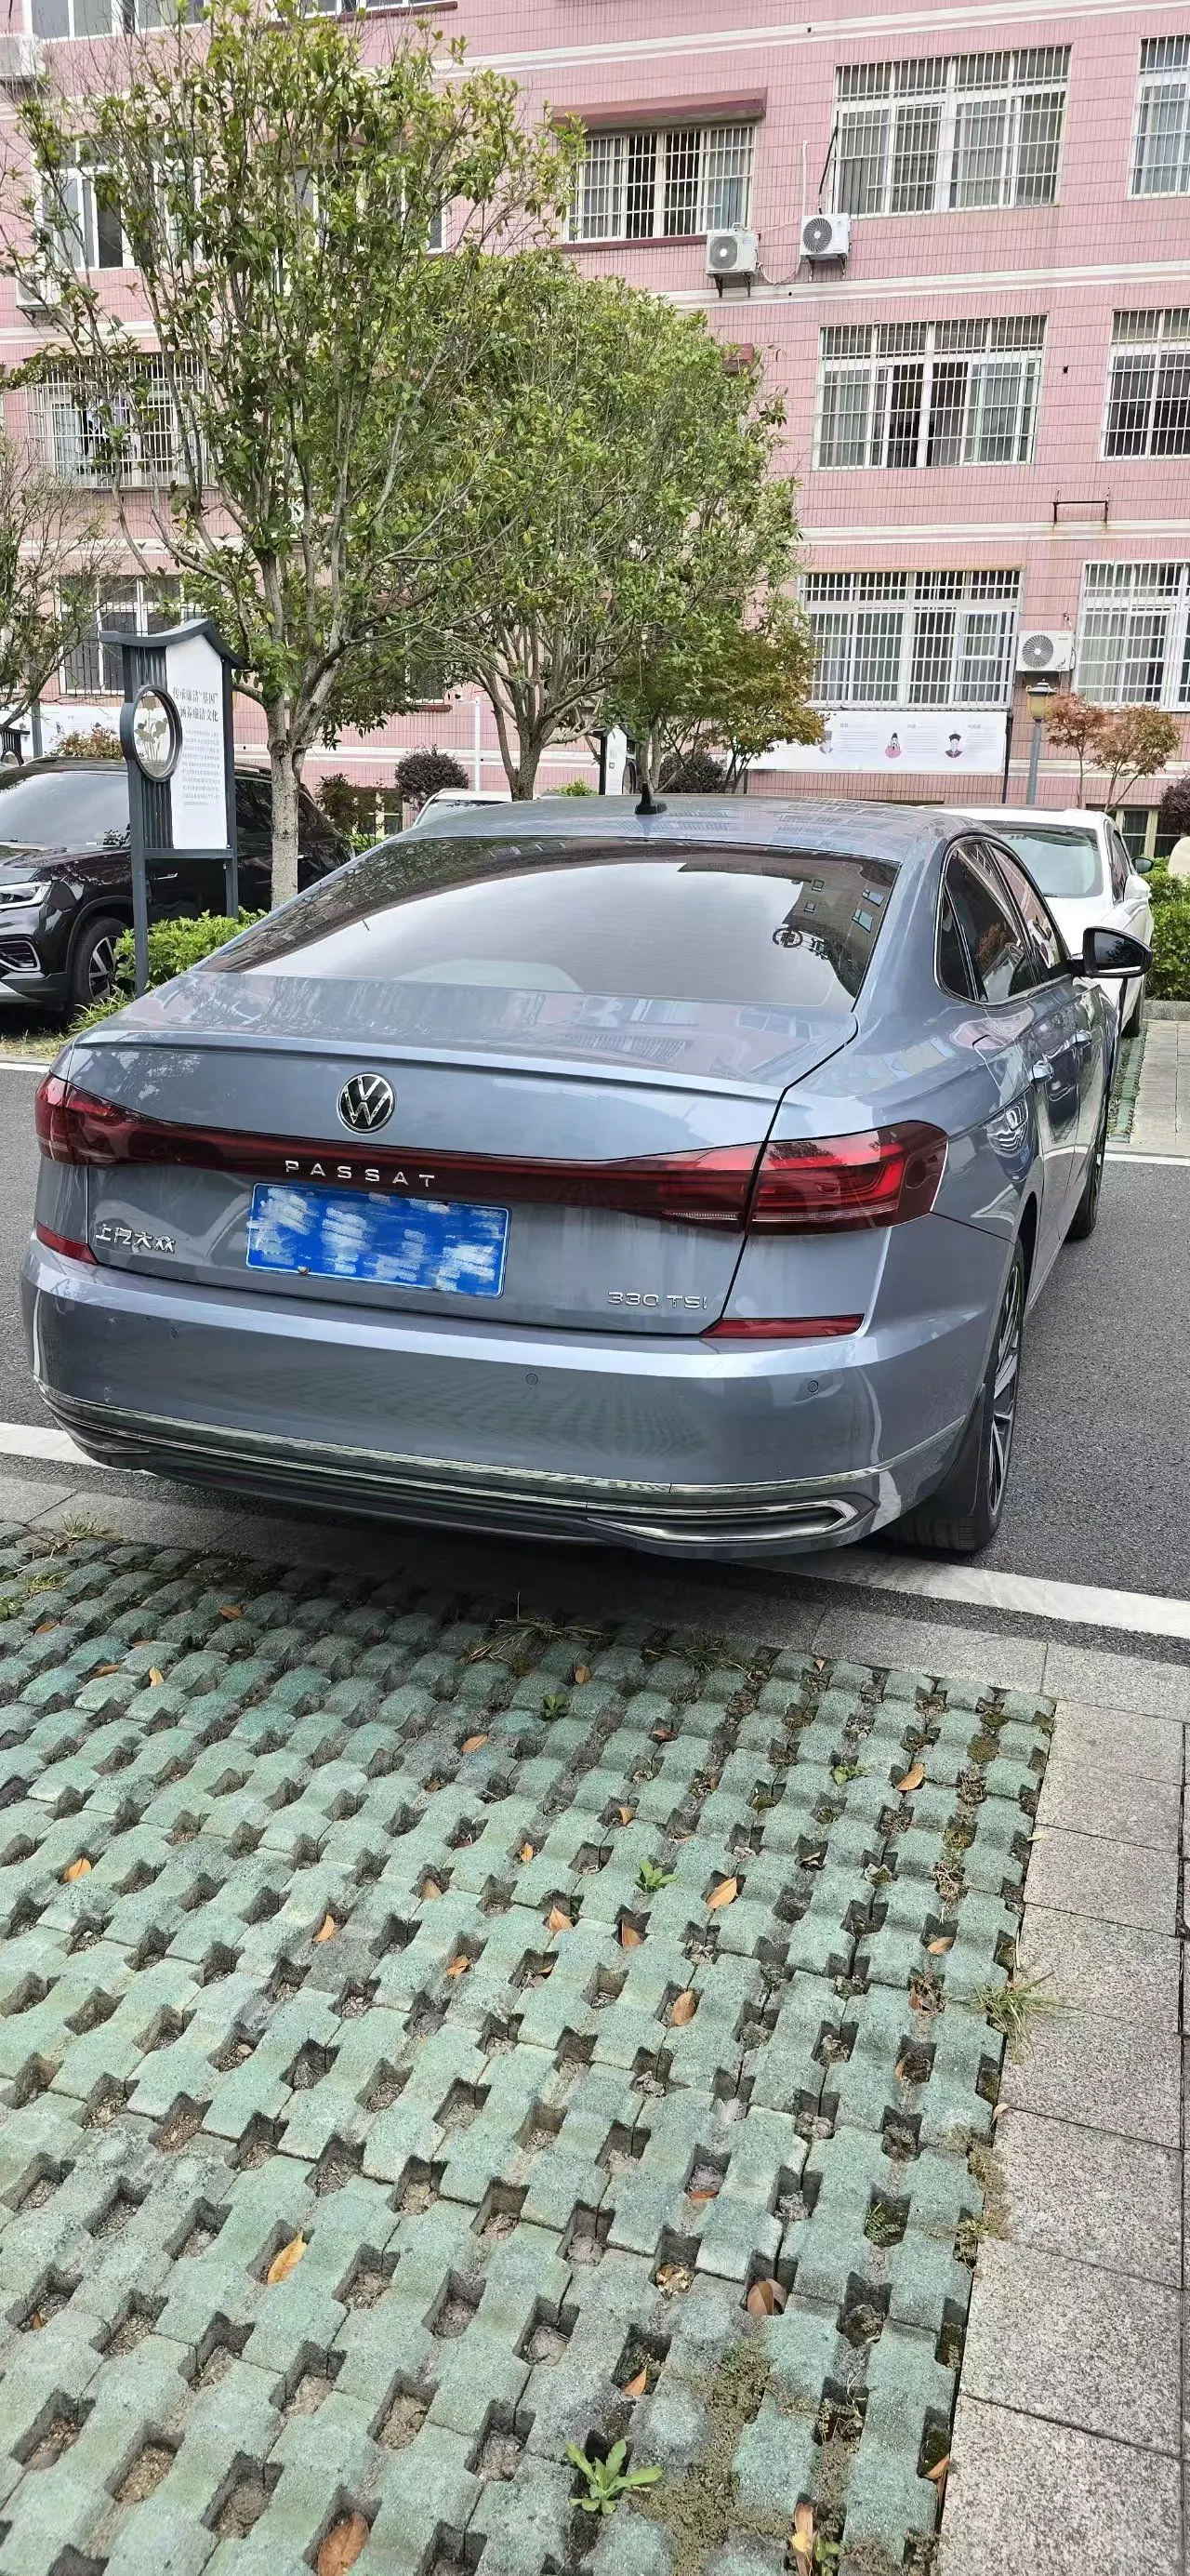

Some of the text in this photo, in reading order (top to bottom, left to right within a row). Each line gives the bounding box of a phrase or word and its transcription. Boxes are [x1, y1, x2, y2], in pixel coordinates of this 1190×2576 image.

[284, 1160, 438, 1188] PASSAT
[95, 1224, 177, 1254] 上汽大众
[607, 1291, 707, 1309] 330 TSI
